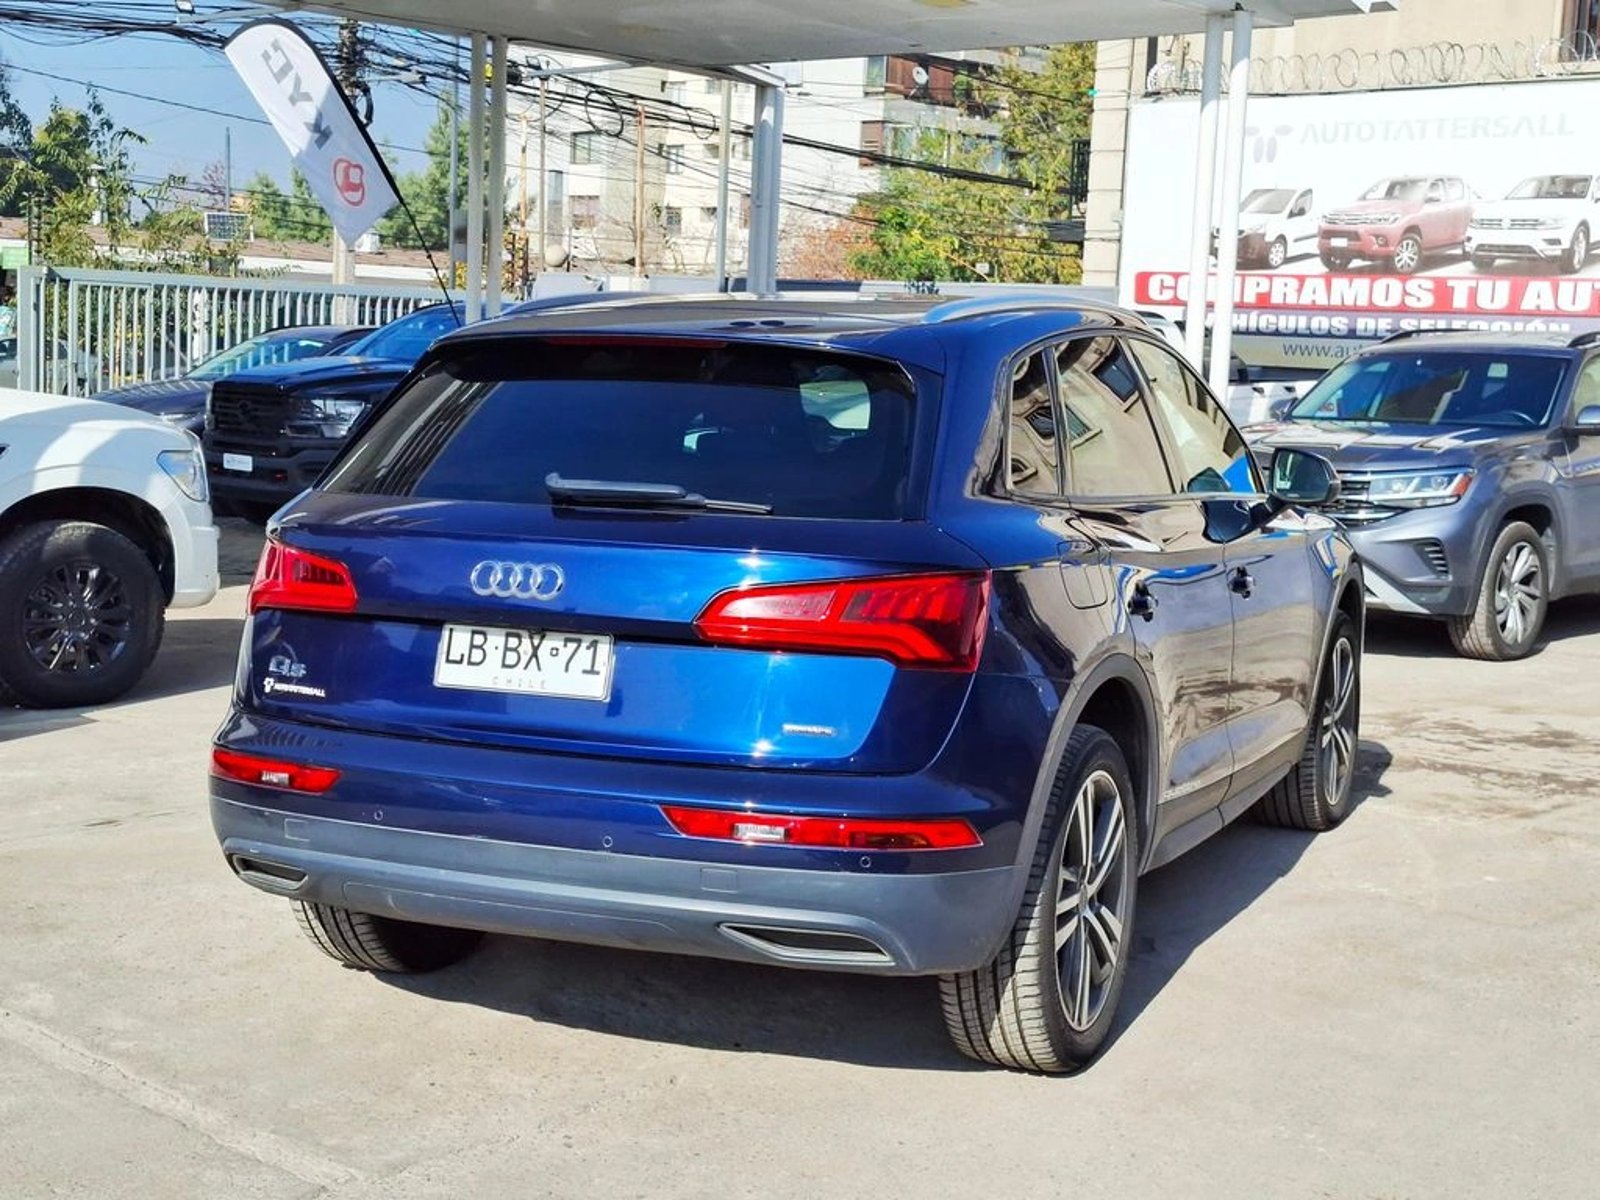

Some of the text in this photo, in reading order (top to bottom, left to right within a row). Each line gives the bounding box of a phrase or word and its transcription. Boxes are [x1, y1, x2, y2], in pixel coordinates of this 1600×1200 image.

[1300, 112, 1575, 145] AUTOTATTERSALL
[1446, 279, 1511, 309] TU
[1203, 310, 1348, 335] HÍCULOS
[1356, 317, 1392, 337] DE
